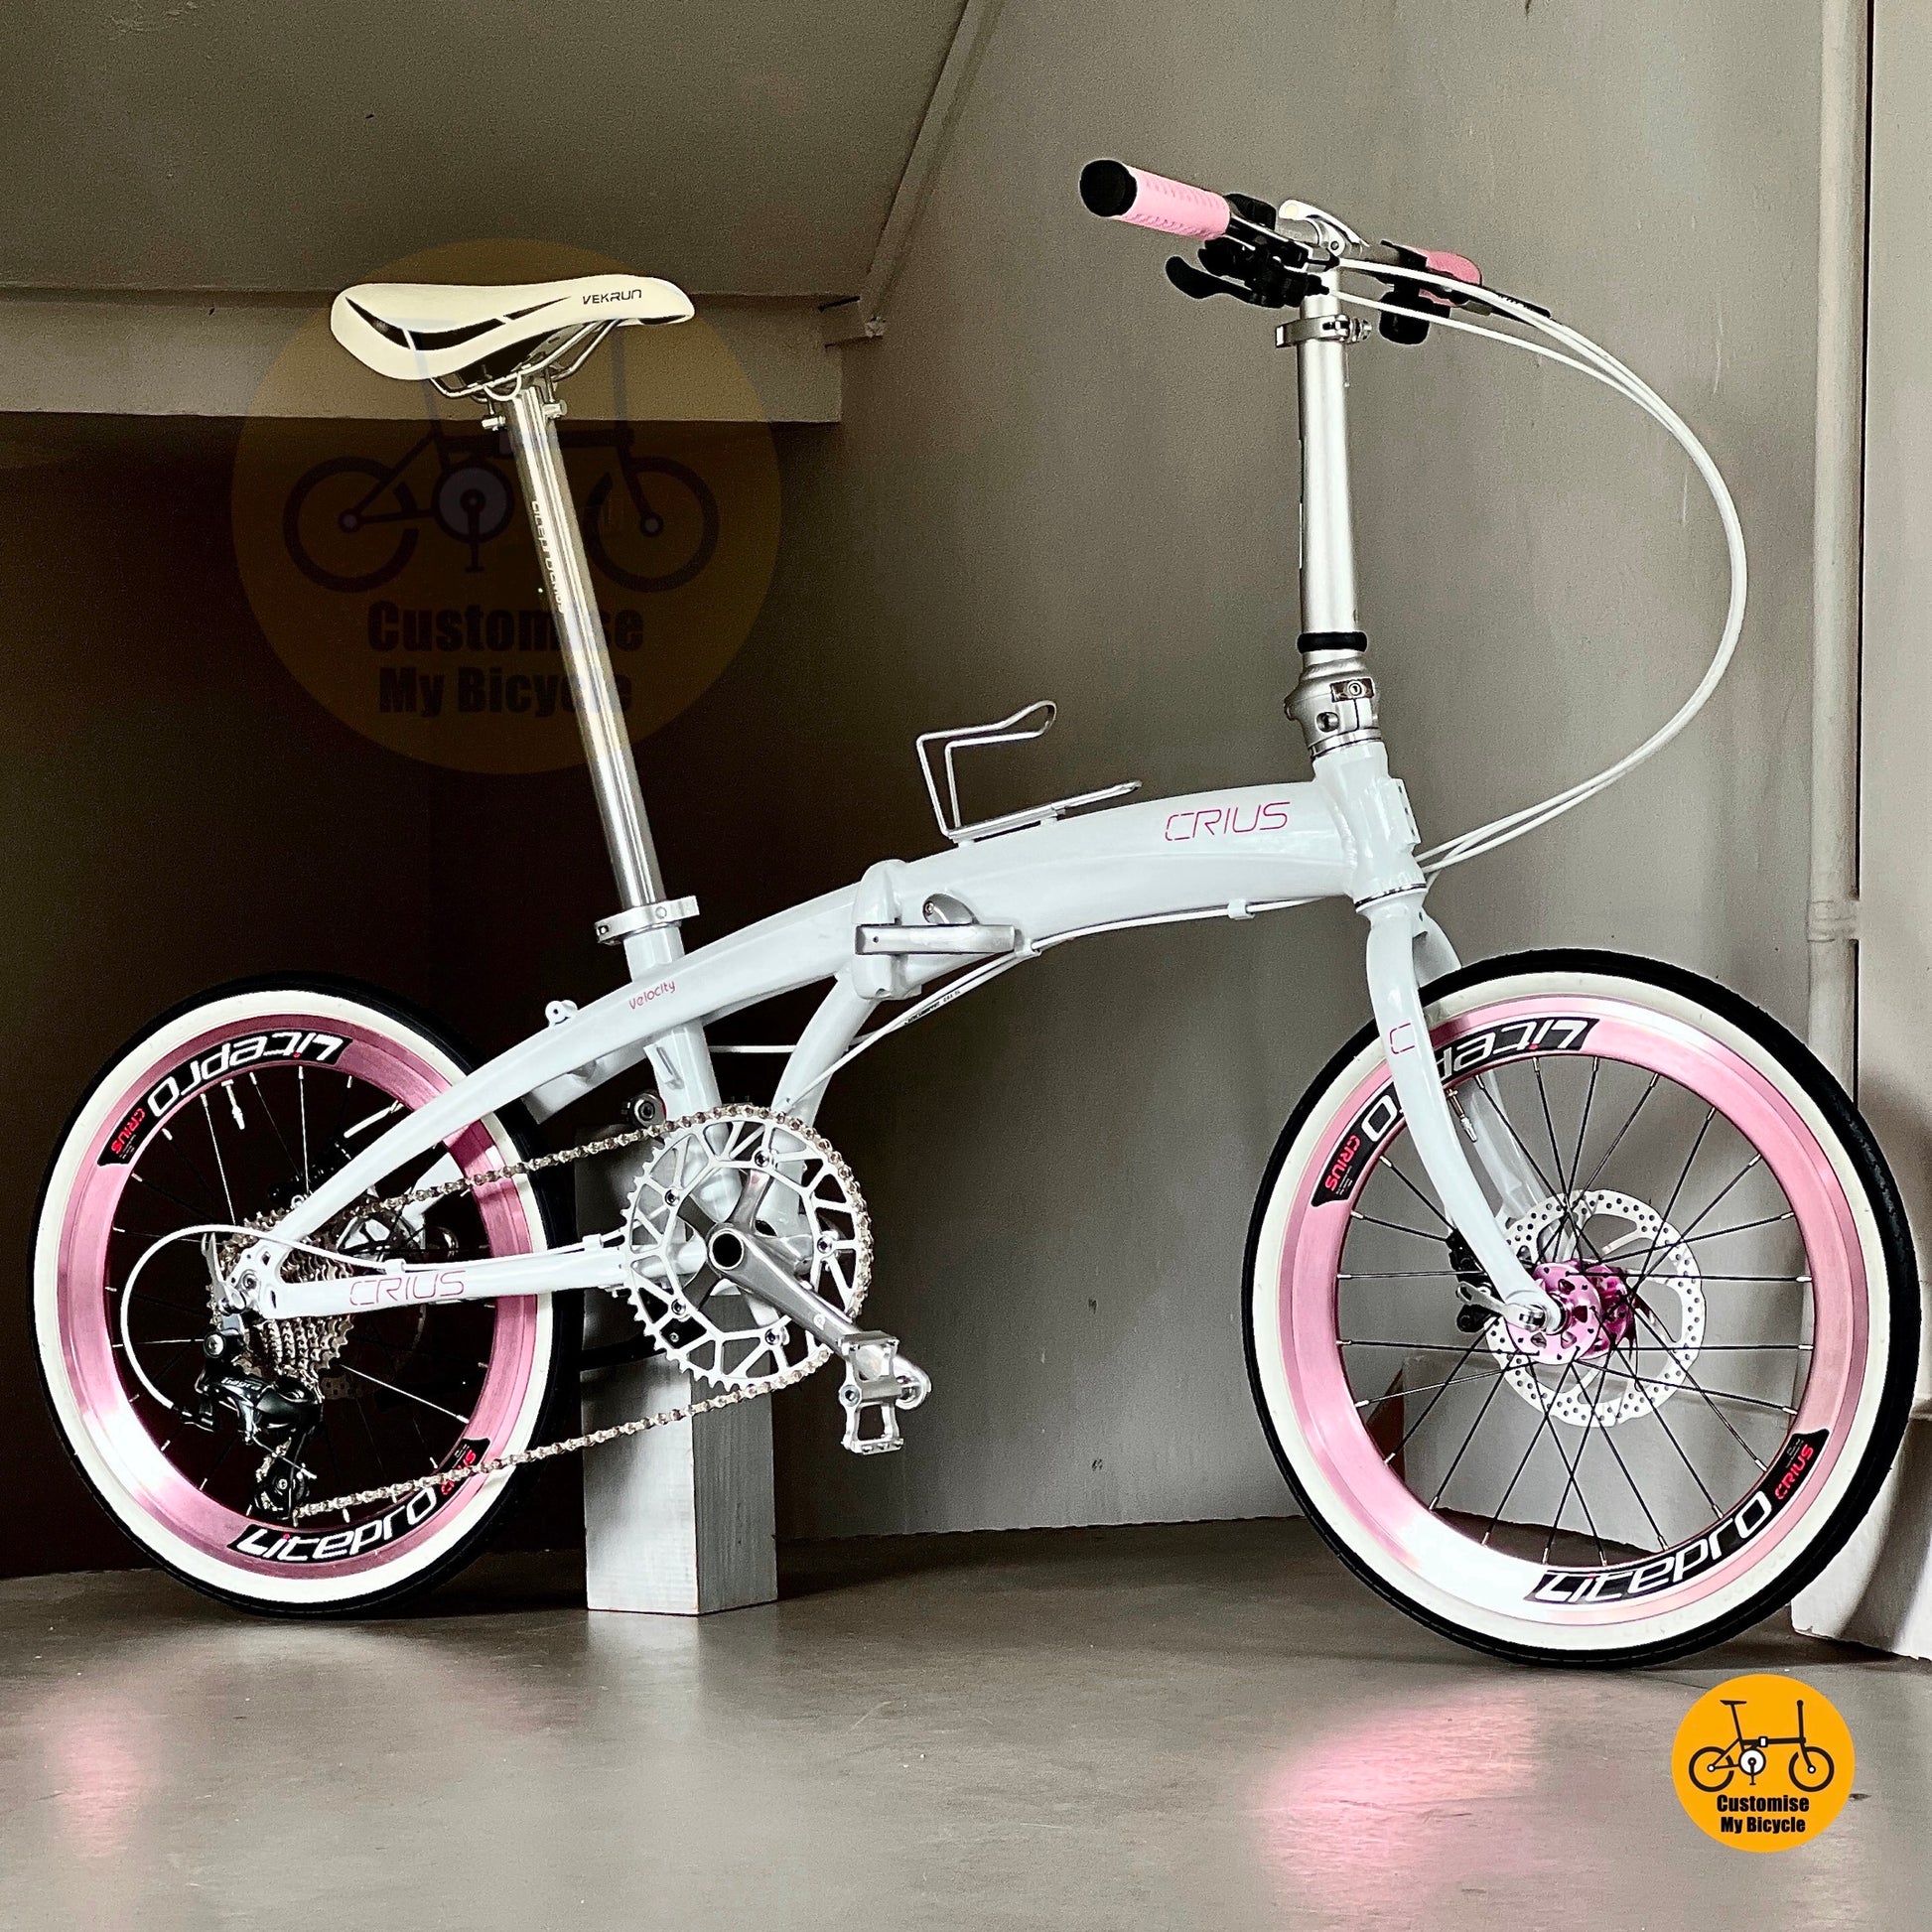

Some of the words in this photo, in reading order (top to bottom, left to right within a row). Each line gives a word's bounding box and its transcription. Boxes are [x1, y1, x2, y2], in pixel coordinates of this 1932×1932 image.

[582, 289, 642, 305] VEKRUN
[1165, 801, 1291, 842] CRIUS
[147, 1032, 344, 1118] Litepro
[111, 1107, 146, 1155] CRIUS
[1324, 1134, 1361, 1192] CRIUS
[349, 1270, 467, 1306] CRIUS
[1774, 1444, 1815, 1500] CRIUS
[1535, 1490, 1772, 1602] Litepro
